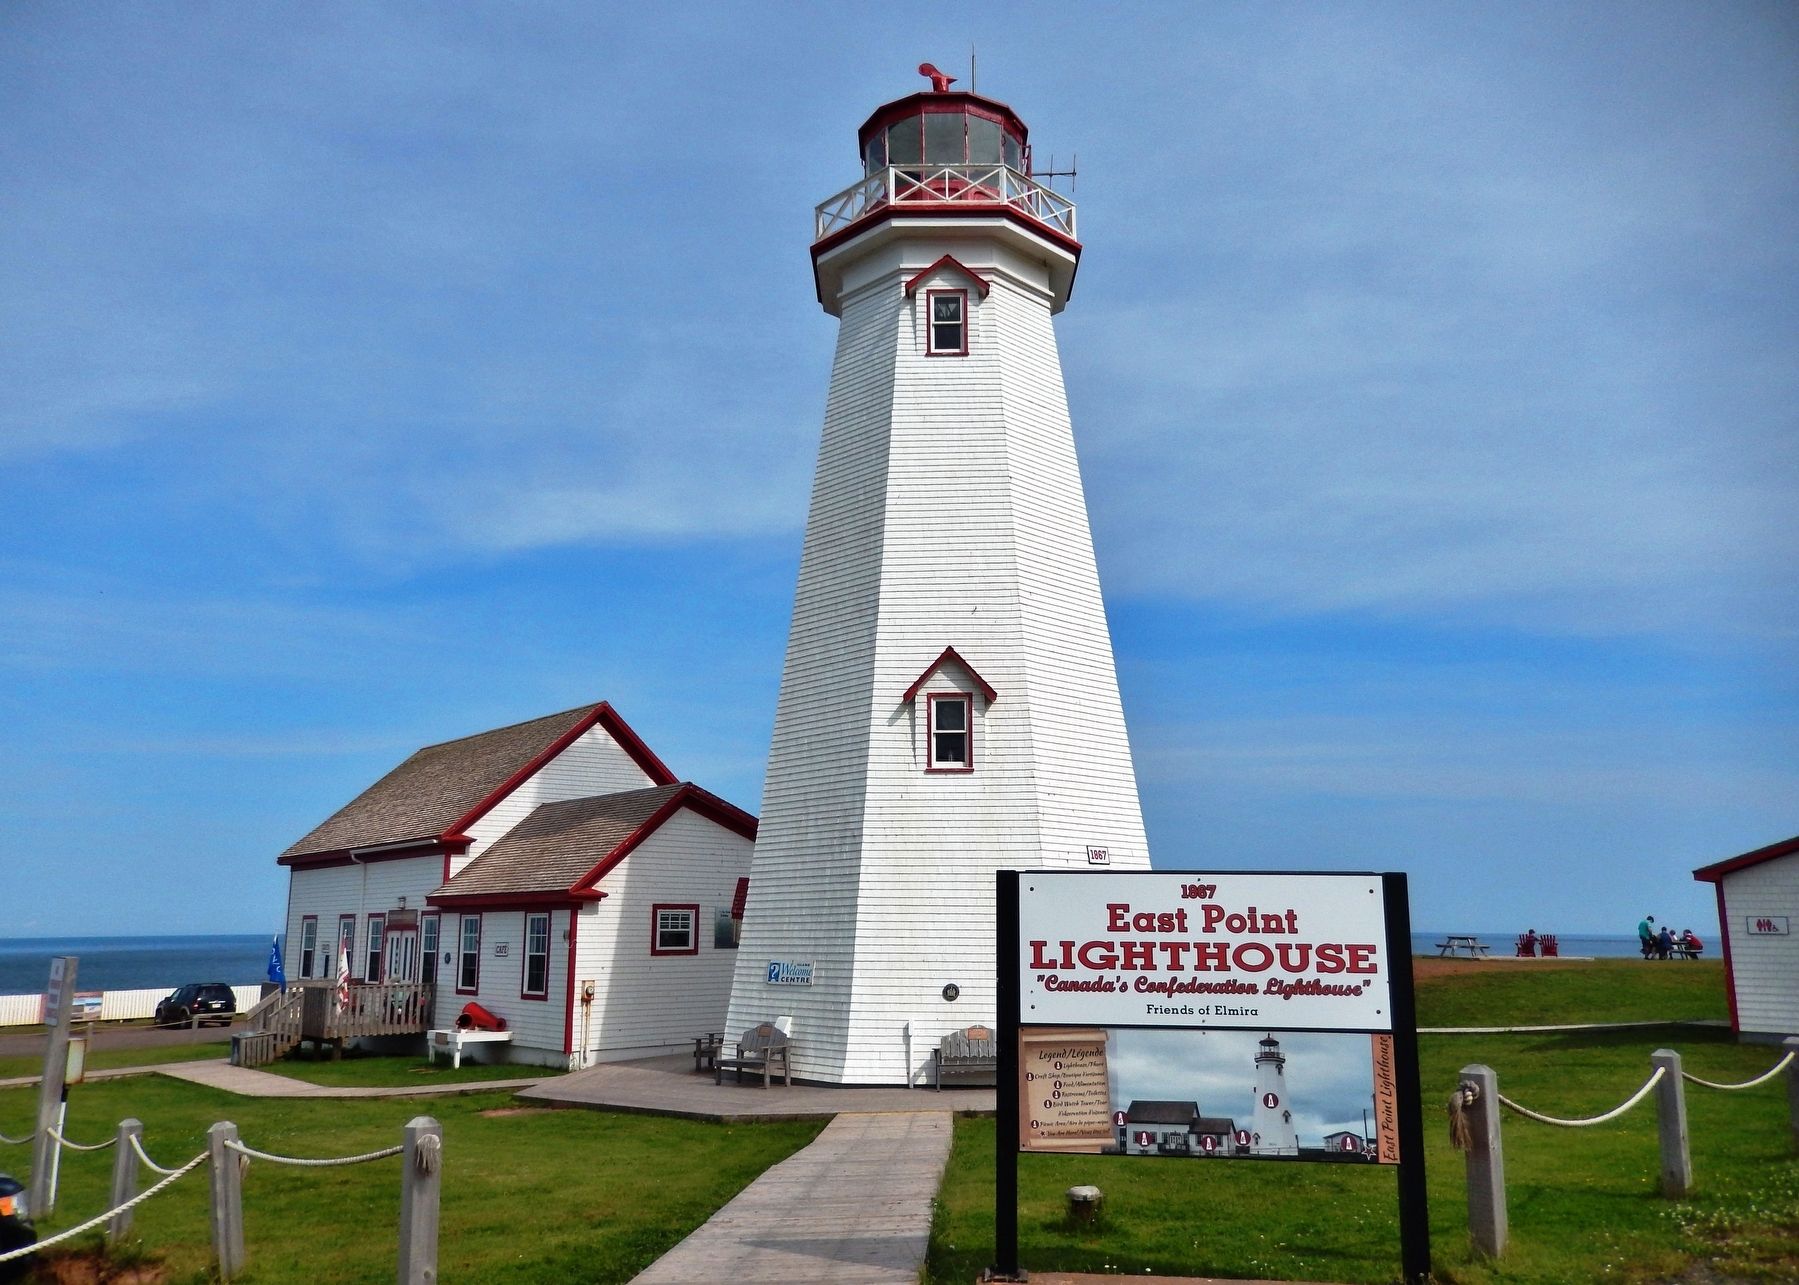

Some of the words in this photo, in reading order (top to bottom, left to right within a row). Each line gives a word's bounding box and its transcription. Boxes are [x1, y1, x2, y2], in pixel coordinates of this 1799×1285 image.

[1090, 849, 1107, 860] 1867
[1180, 883, 1217, 899] 1867
[1106, 903, 1188, 933] East
[1201, 904, 1298, 934] Point
[781, 962, 812, 976] Welcome
[1029, 940, 1378, 974] LIGHTHOUSE
[1134, 976, 1258, 998] Confederation
[1263, 979, 1371, 1000] Lighthouse"
[1146, 1004, 1194, 1016] Friends
[1198, 1004, 1210, 1016] of
[1214, 1004, 1259, 1017] Elmira
[1377, 1036, 1395, 1097] Lighthouse
[1381, 1100, 1393, 1132] Point
[1383, 1134, 1397, 1161] East
